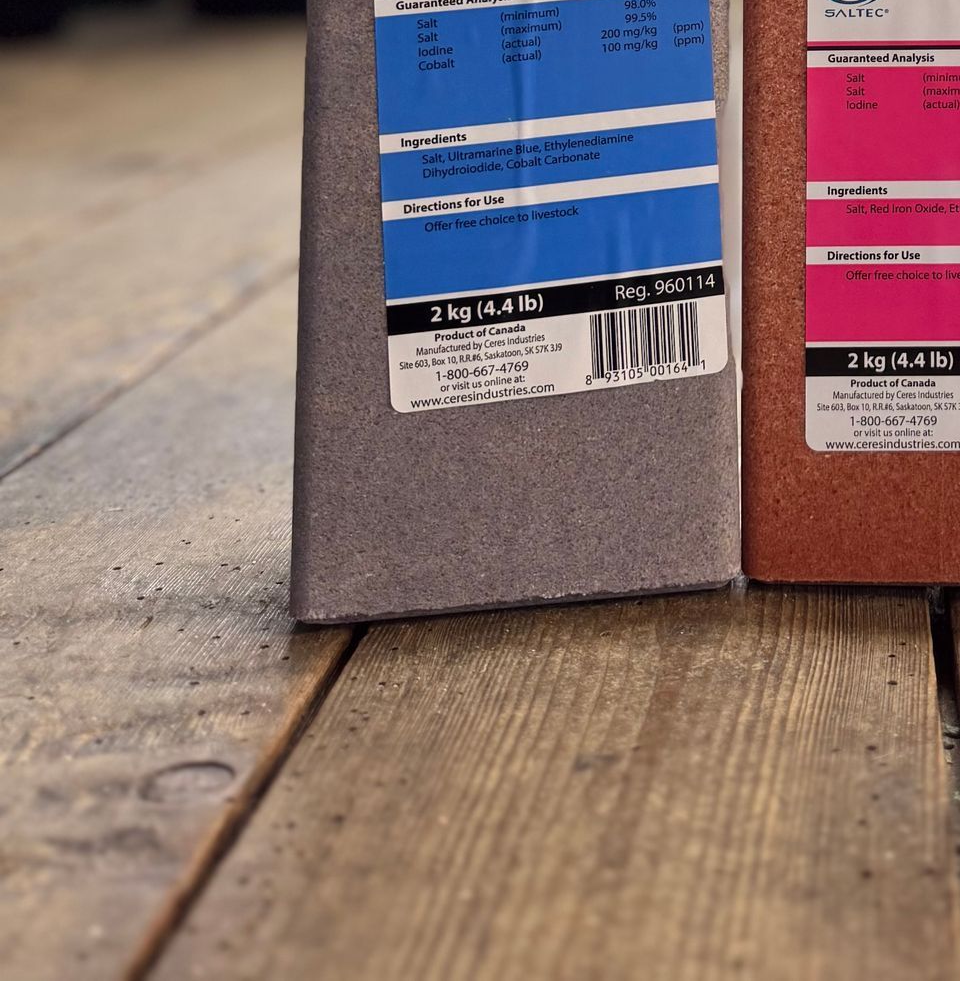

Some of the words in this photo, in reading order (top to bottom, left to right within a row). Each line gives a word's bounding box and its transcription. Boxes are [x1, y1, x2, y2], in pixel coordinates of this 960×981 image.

[416, 17, 438, 29] Salt
[500, 6, 559, 23] (minimum)
[417, 31, 438, 43] Salt
[500, 19, 562, 36] (maximum)
[624, 11, 657, 23] 99.5%
[418, 45, 453, 57] Iodine
[501, 35, 540, 50] (actual)
[600, 28, 620, 40] 200
[622, 25, 657, 38] mg/kg
[672, 20, 704, 34] (ppm)
[417, 57, 455, 71] Cobalt
[501, 49, 541, 64] (actual)
[601, 41, 621, 52] 100
[623, 38, 657, 52] mg/kg
[673, 33, 704, 47] (ppm)
[827, 52, 889, 63] Guaranteed
[891, 52, 934, 64] Analysis
[845, 73, 865, 83] Salt
[845, 85, 865, 96] Salt
[846, 98, 878, 109] Iodine
[922, 98, 960, 110] (actual)
[400, 132, 467, 148] Ingredients
[421, 152, 445, 164] Salt,
[447, 146, 513, 161] Ultramarine
[515, 142, 541, 154] Blue,
[543, 133, 633, 152] Ethylenediamine
[422, 160, 503, 179] Dihydroiodide,
[505, 155, 542, 169] Cobalt
[543, 150, 600, 165] Carbonate
[827, 185, 887, 197] Ingredients
[403, 200, 462, 214] Directions
[463, 197, 481, 207] for
[483, 195, 504, 205] Use
[845, 201, 867, 214] Salt,
[869, 203, 889, 213] Red
[891, 202, 912, 213] Iron
[914, 202, 947, 214] Oxide,
[424, 220, 453, 232] Offer
[454, 218, 476, 229] free
[478, 213, 515, 226] choice
[516, 212, 529, 222] to
[531, 206, 579, 220] livestock
[827, 250, 881, 260] Directions
[882, 250, 899, 259] for
[901, 250, 920, 259] Use
[845, 269, 873, 280] Offer
[873, 269, 894, 280] free
[895, 269, 929, 279] choice
[931, 270, 944, 280] to
[615, 284, 650, 301] Reg.
[654, 273, 715, 295] 960114
[430, 305, 442, 322] 2
[447, 303, 471, 323] kg
[476, 297, 513, 319] (4.4
[518, 293, 543, 312] lb)
[434, 329, 474, 342] Product
[475, 327, 486, 337] of
[488, 323, 525, 335] Canada
[435, 360, 528, 381] 1-800-667-4769
[847, 352, 858, 368] 2
[863, 351, 885, 372] kg
[891, 351, 925, 370] (4.4
[930, 351, 953, 370] lb)
[850, 378, 887, 387] Product
[889, 378, 899, 387] of
[900, 378, 935, 387] Canada
[410, 383, 554, 408] www.ceresindustries.com
[832, 389, 884, 399] Manufactured
[885, 390, 895, 400] by
[895, 389, 916, 399] Ceres
[917, 390, 953, 399] Industries
[850, 415, 937, 426] 1-800-667-4769
[825, 438, 960, 449] www.ceresindustries.com
